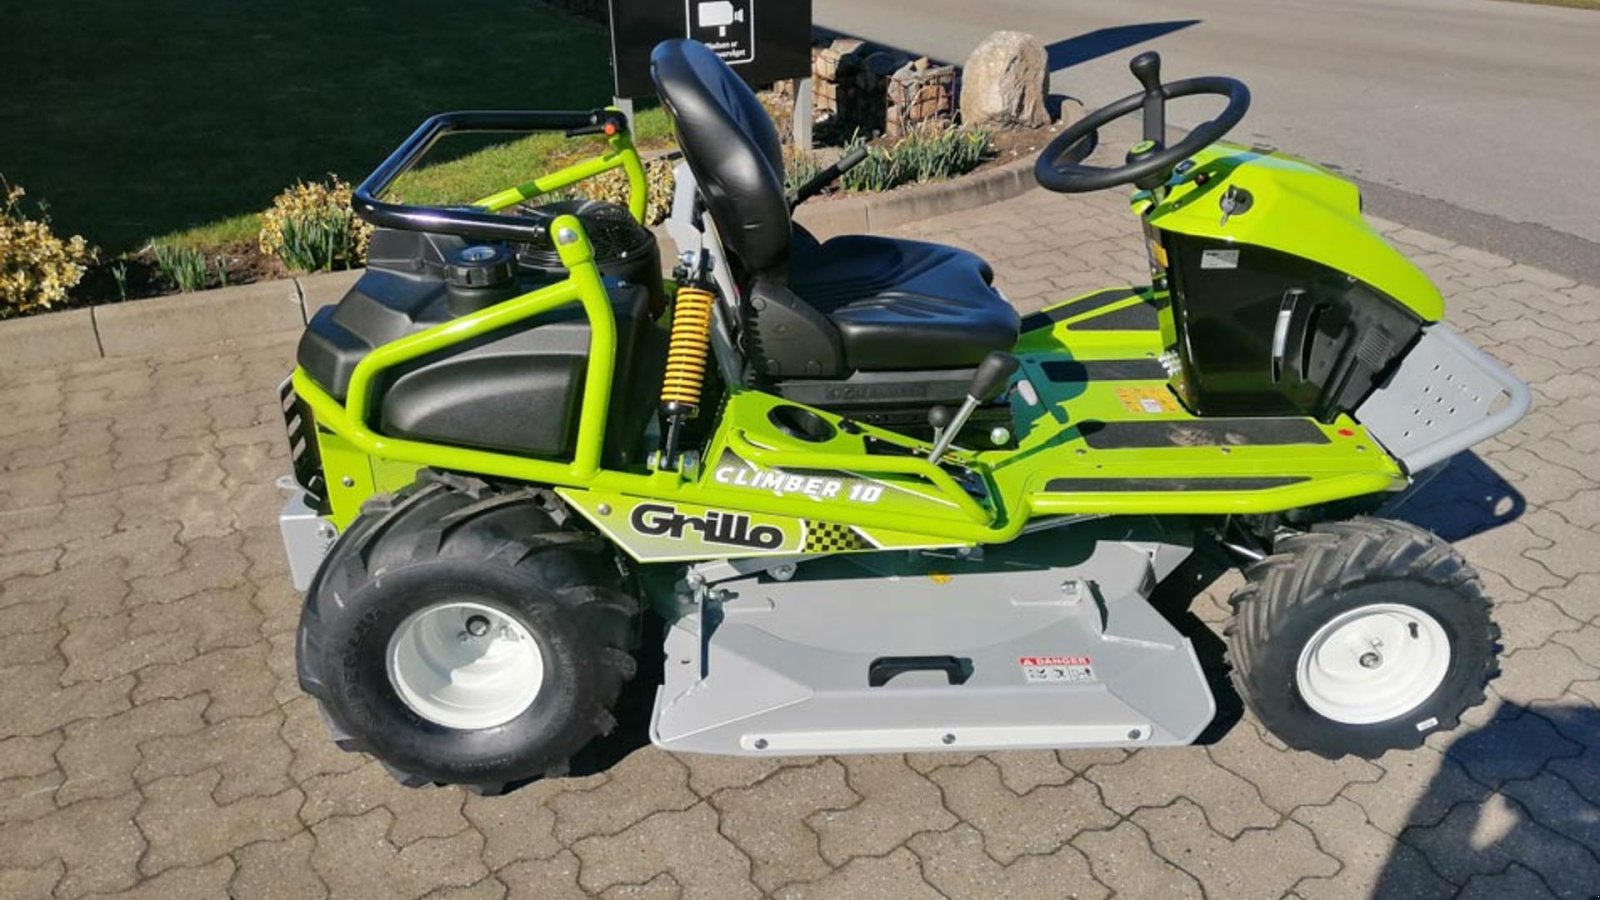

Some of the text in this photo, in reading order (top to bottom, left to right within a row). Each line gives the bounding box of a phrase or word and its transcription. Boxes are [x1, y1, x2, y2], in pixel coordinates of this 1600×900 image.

[714, 466, 885, 503] CLIMBER 10
[631, 503, 783, 550] Grillo
[1036, 657, 1087, 666] DANGER
